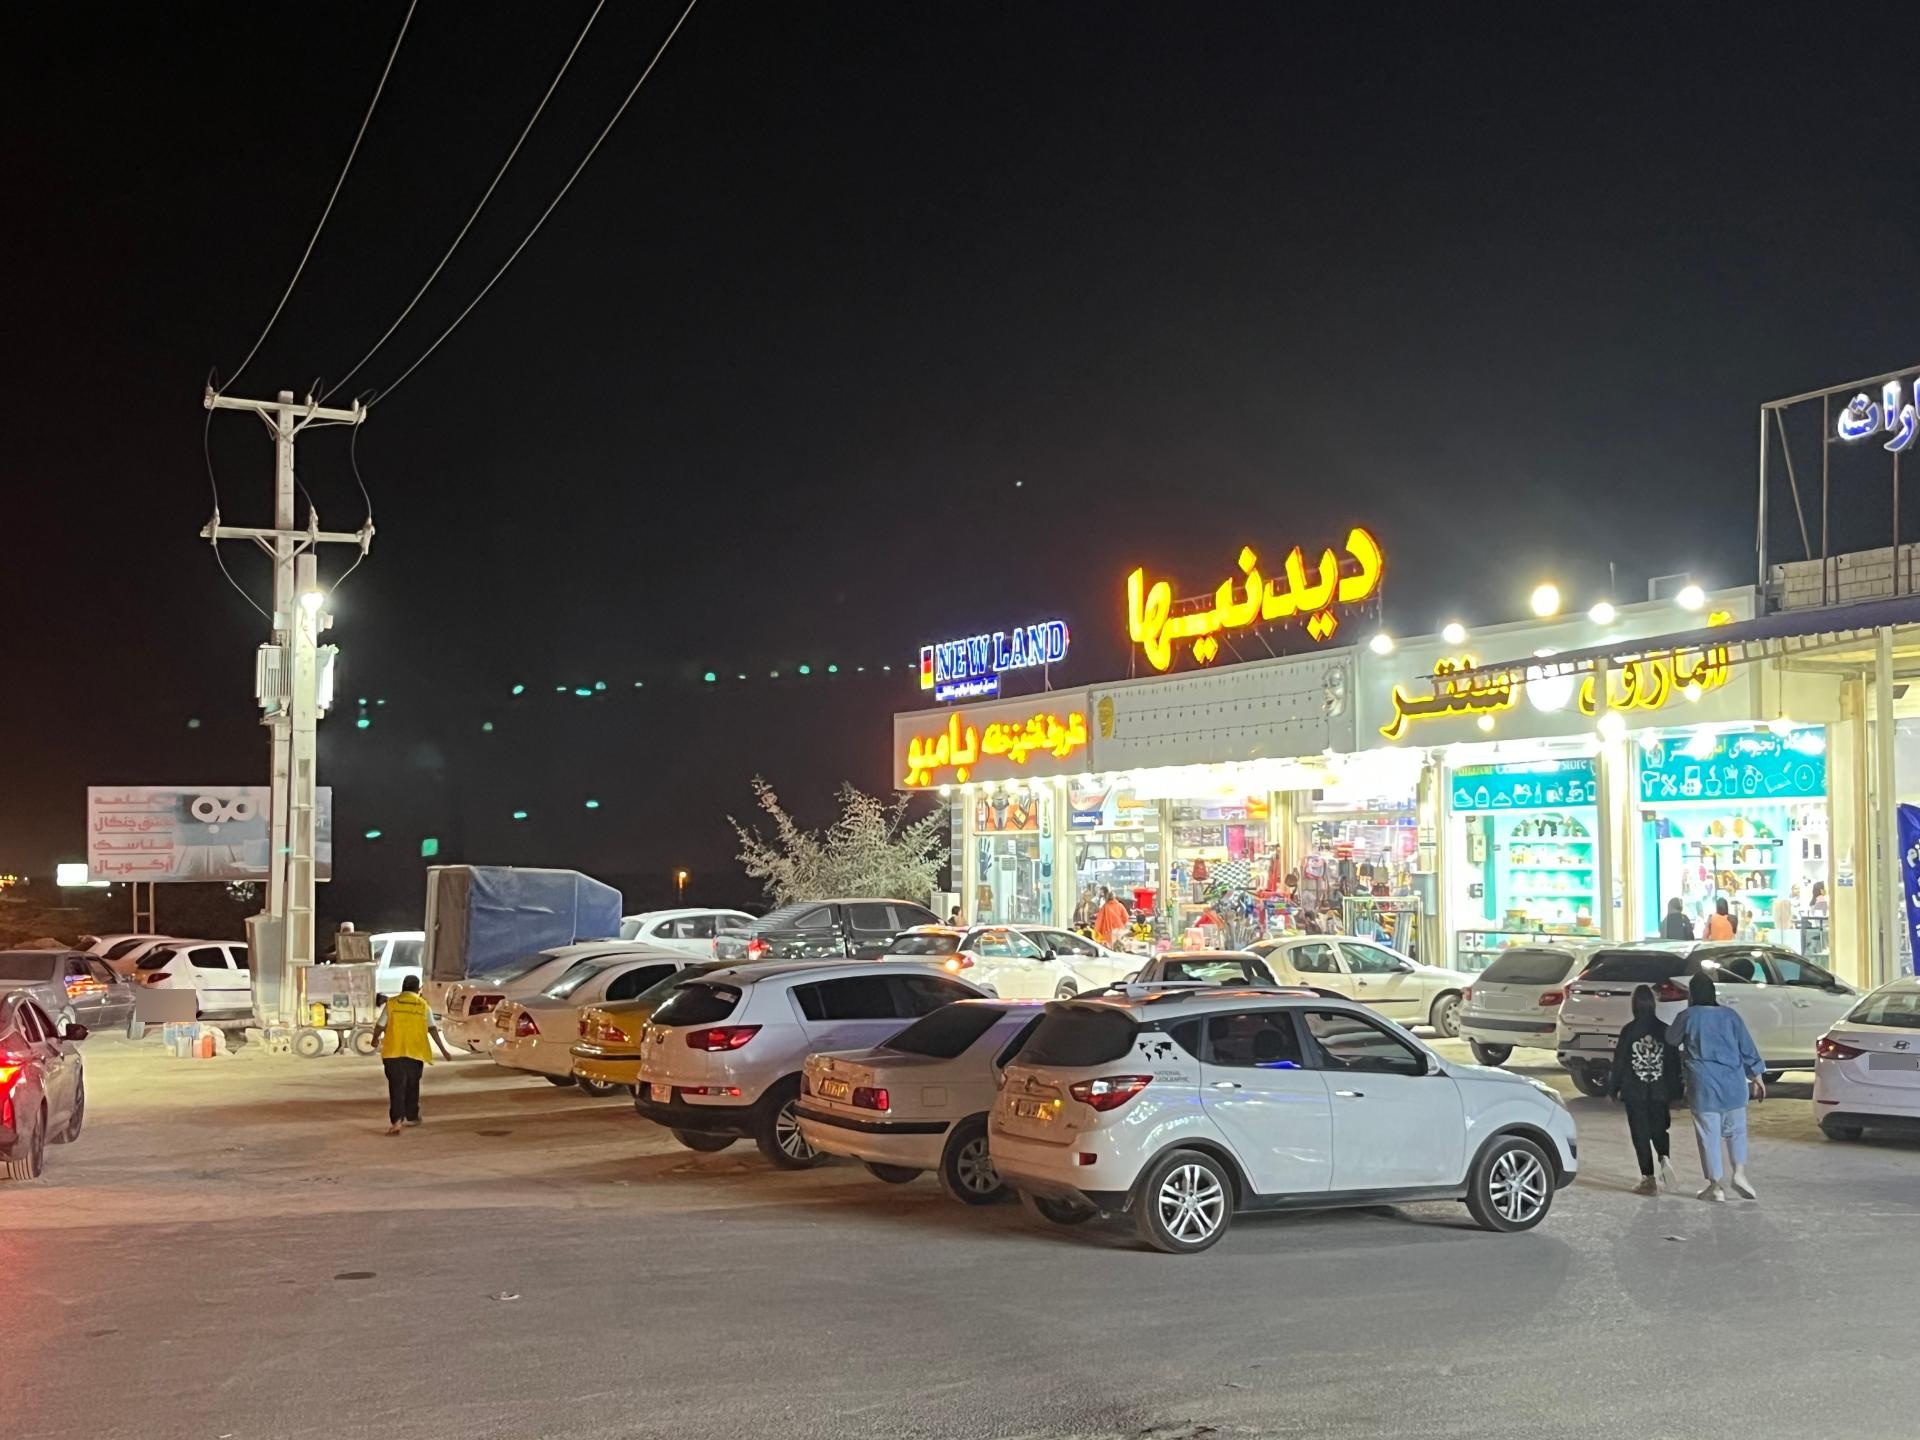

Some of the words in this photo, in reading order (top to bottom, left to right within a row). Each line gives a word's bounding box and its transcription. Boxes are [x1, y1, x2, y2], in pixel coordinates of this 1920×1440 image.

[1126, 527, 1385, 672] دیدنیها
[935, 633, 990, 682] NEW
[992, 619, 1070, 672] LAND
[1379, 654, 1519, 741] سنتر
[903, 711, 979, 786] بامبو
[93, 855, 176, 875] آرکوپال
